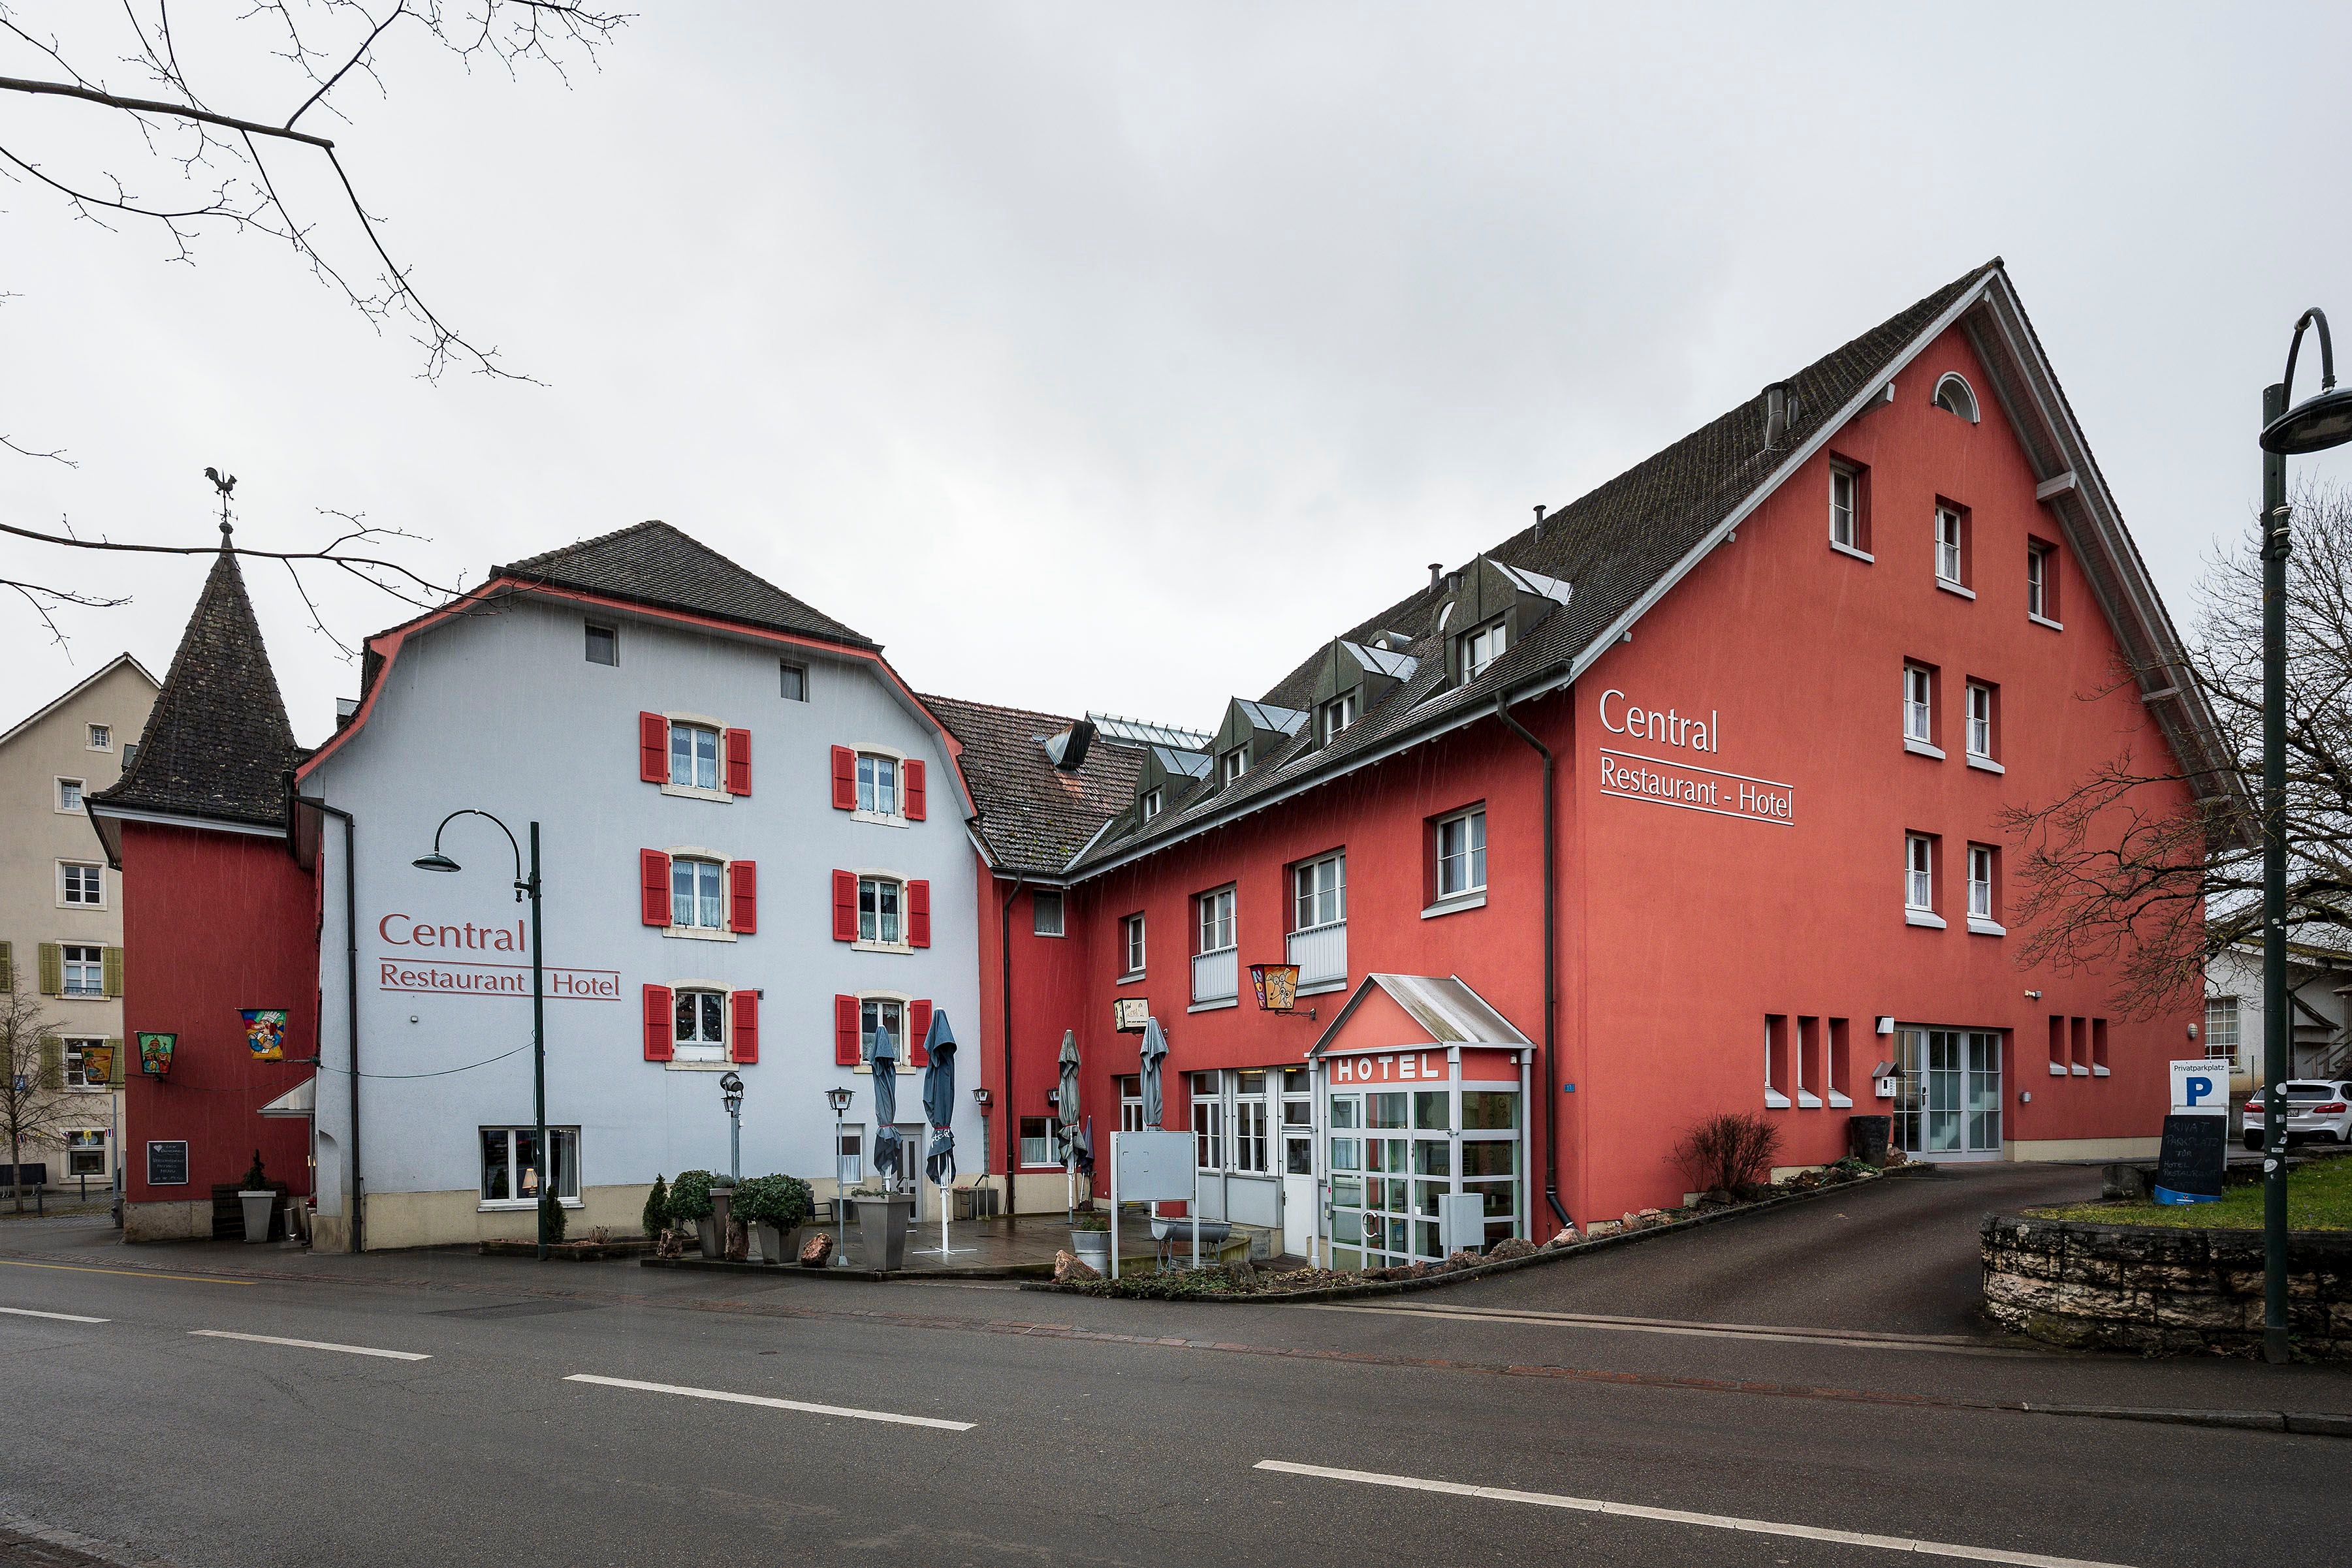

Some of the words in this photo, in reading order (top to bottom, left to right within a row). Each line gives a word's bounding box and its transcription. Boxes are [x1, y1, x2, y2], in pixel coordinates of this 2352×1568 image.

[1600, 689, 1718, 753] Central
[1601, 757, 1718, 806] Restaurant
[1740, 783, 1793, 818] Hotel
[379, 913, 525, 952] Central
[380, 964, 525, 992] Restaurant
[553, 973, 620, 996] Hotel
[1338, 1053, 1439, 1082] HOTEL
[2186, 1076, 2212, 1106] P
